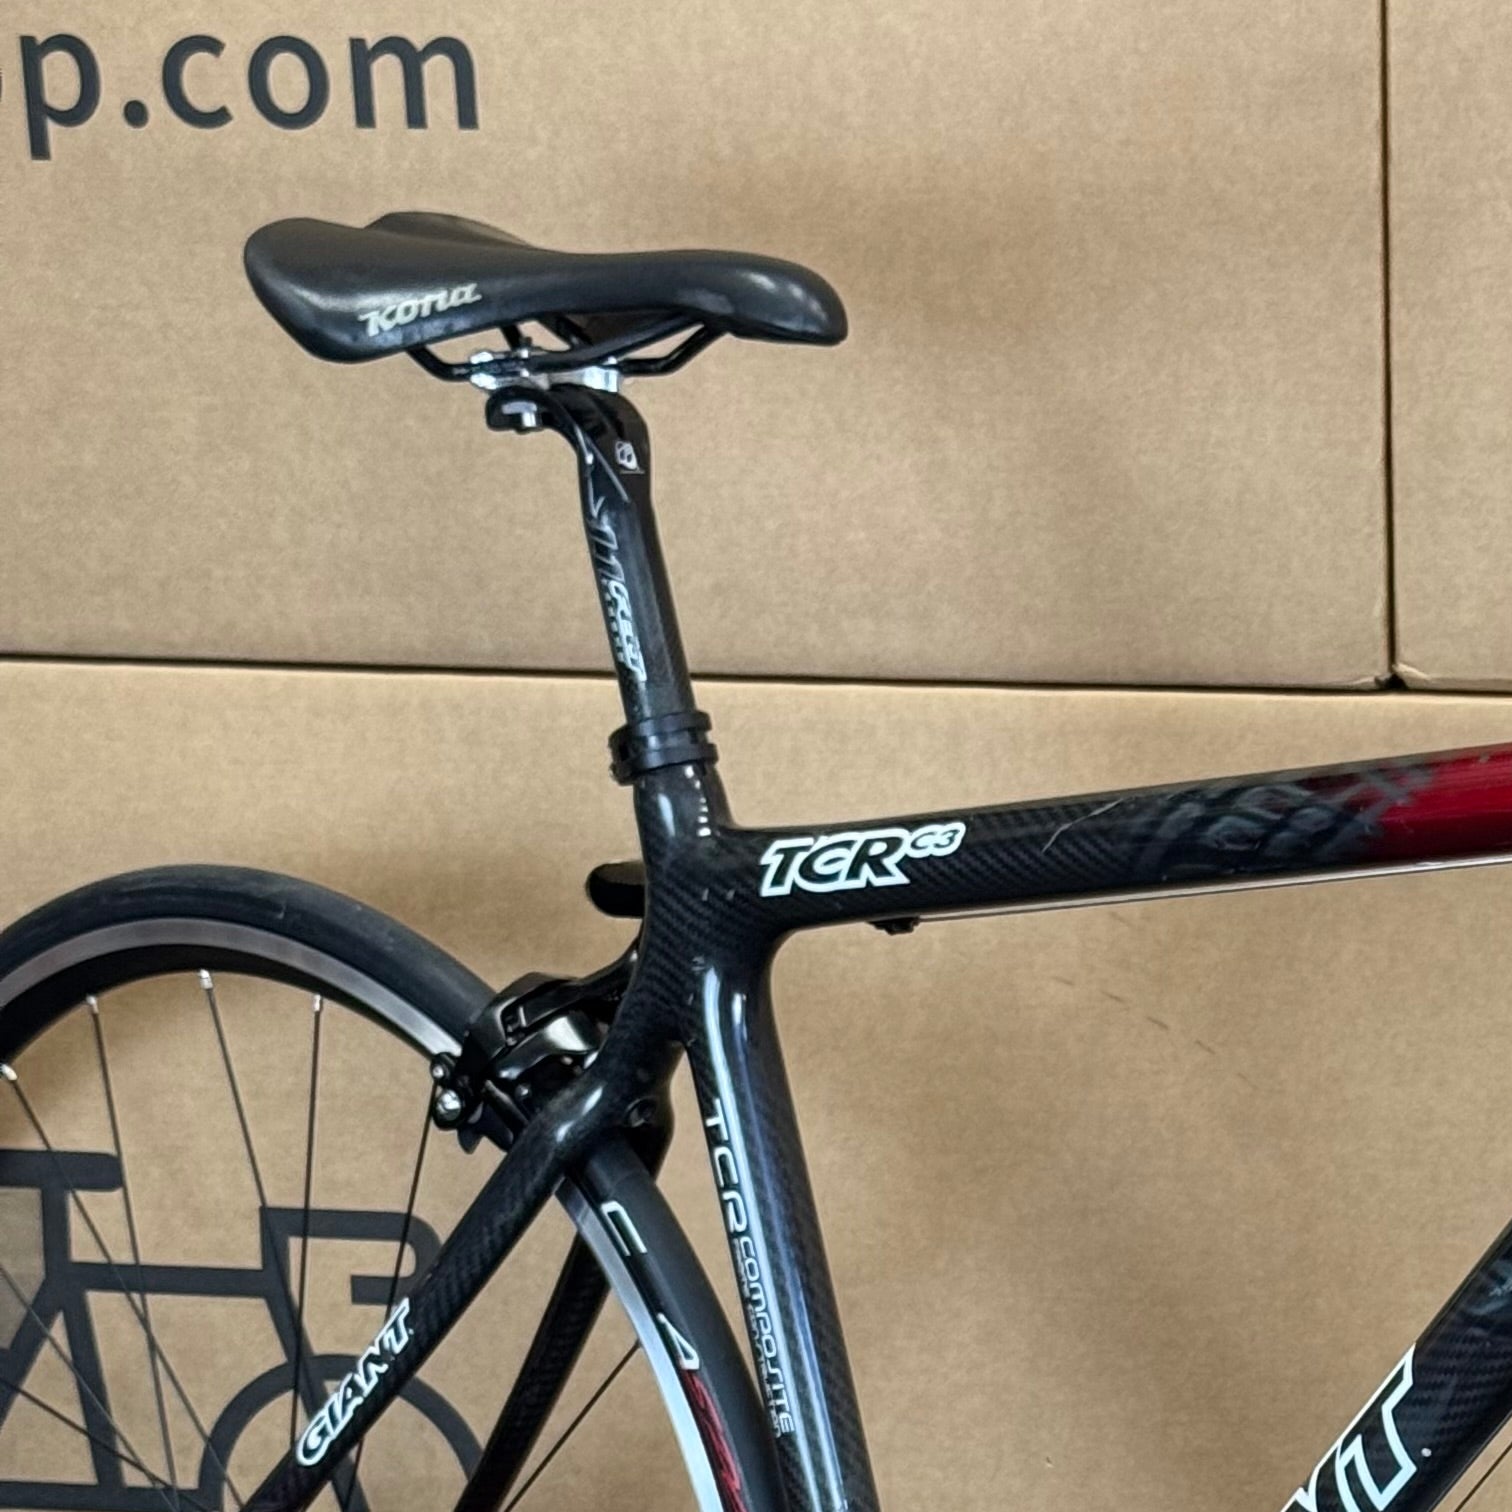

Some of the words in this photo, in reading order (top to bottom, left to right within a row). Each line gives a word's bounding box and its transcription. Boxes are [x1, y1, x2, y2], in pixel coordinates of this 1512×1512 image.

[0, 34, 479, 161] p.com
[760, 828, 910, 897] TCR
[903, 822, 966, 857] C3
[705, 1098, 748, 1233] TCR
[296, 1297, 412, 1467] GIANT
